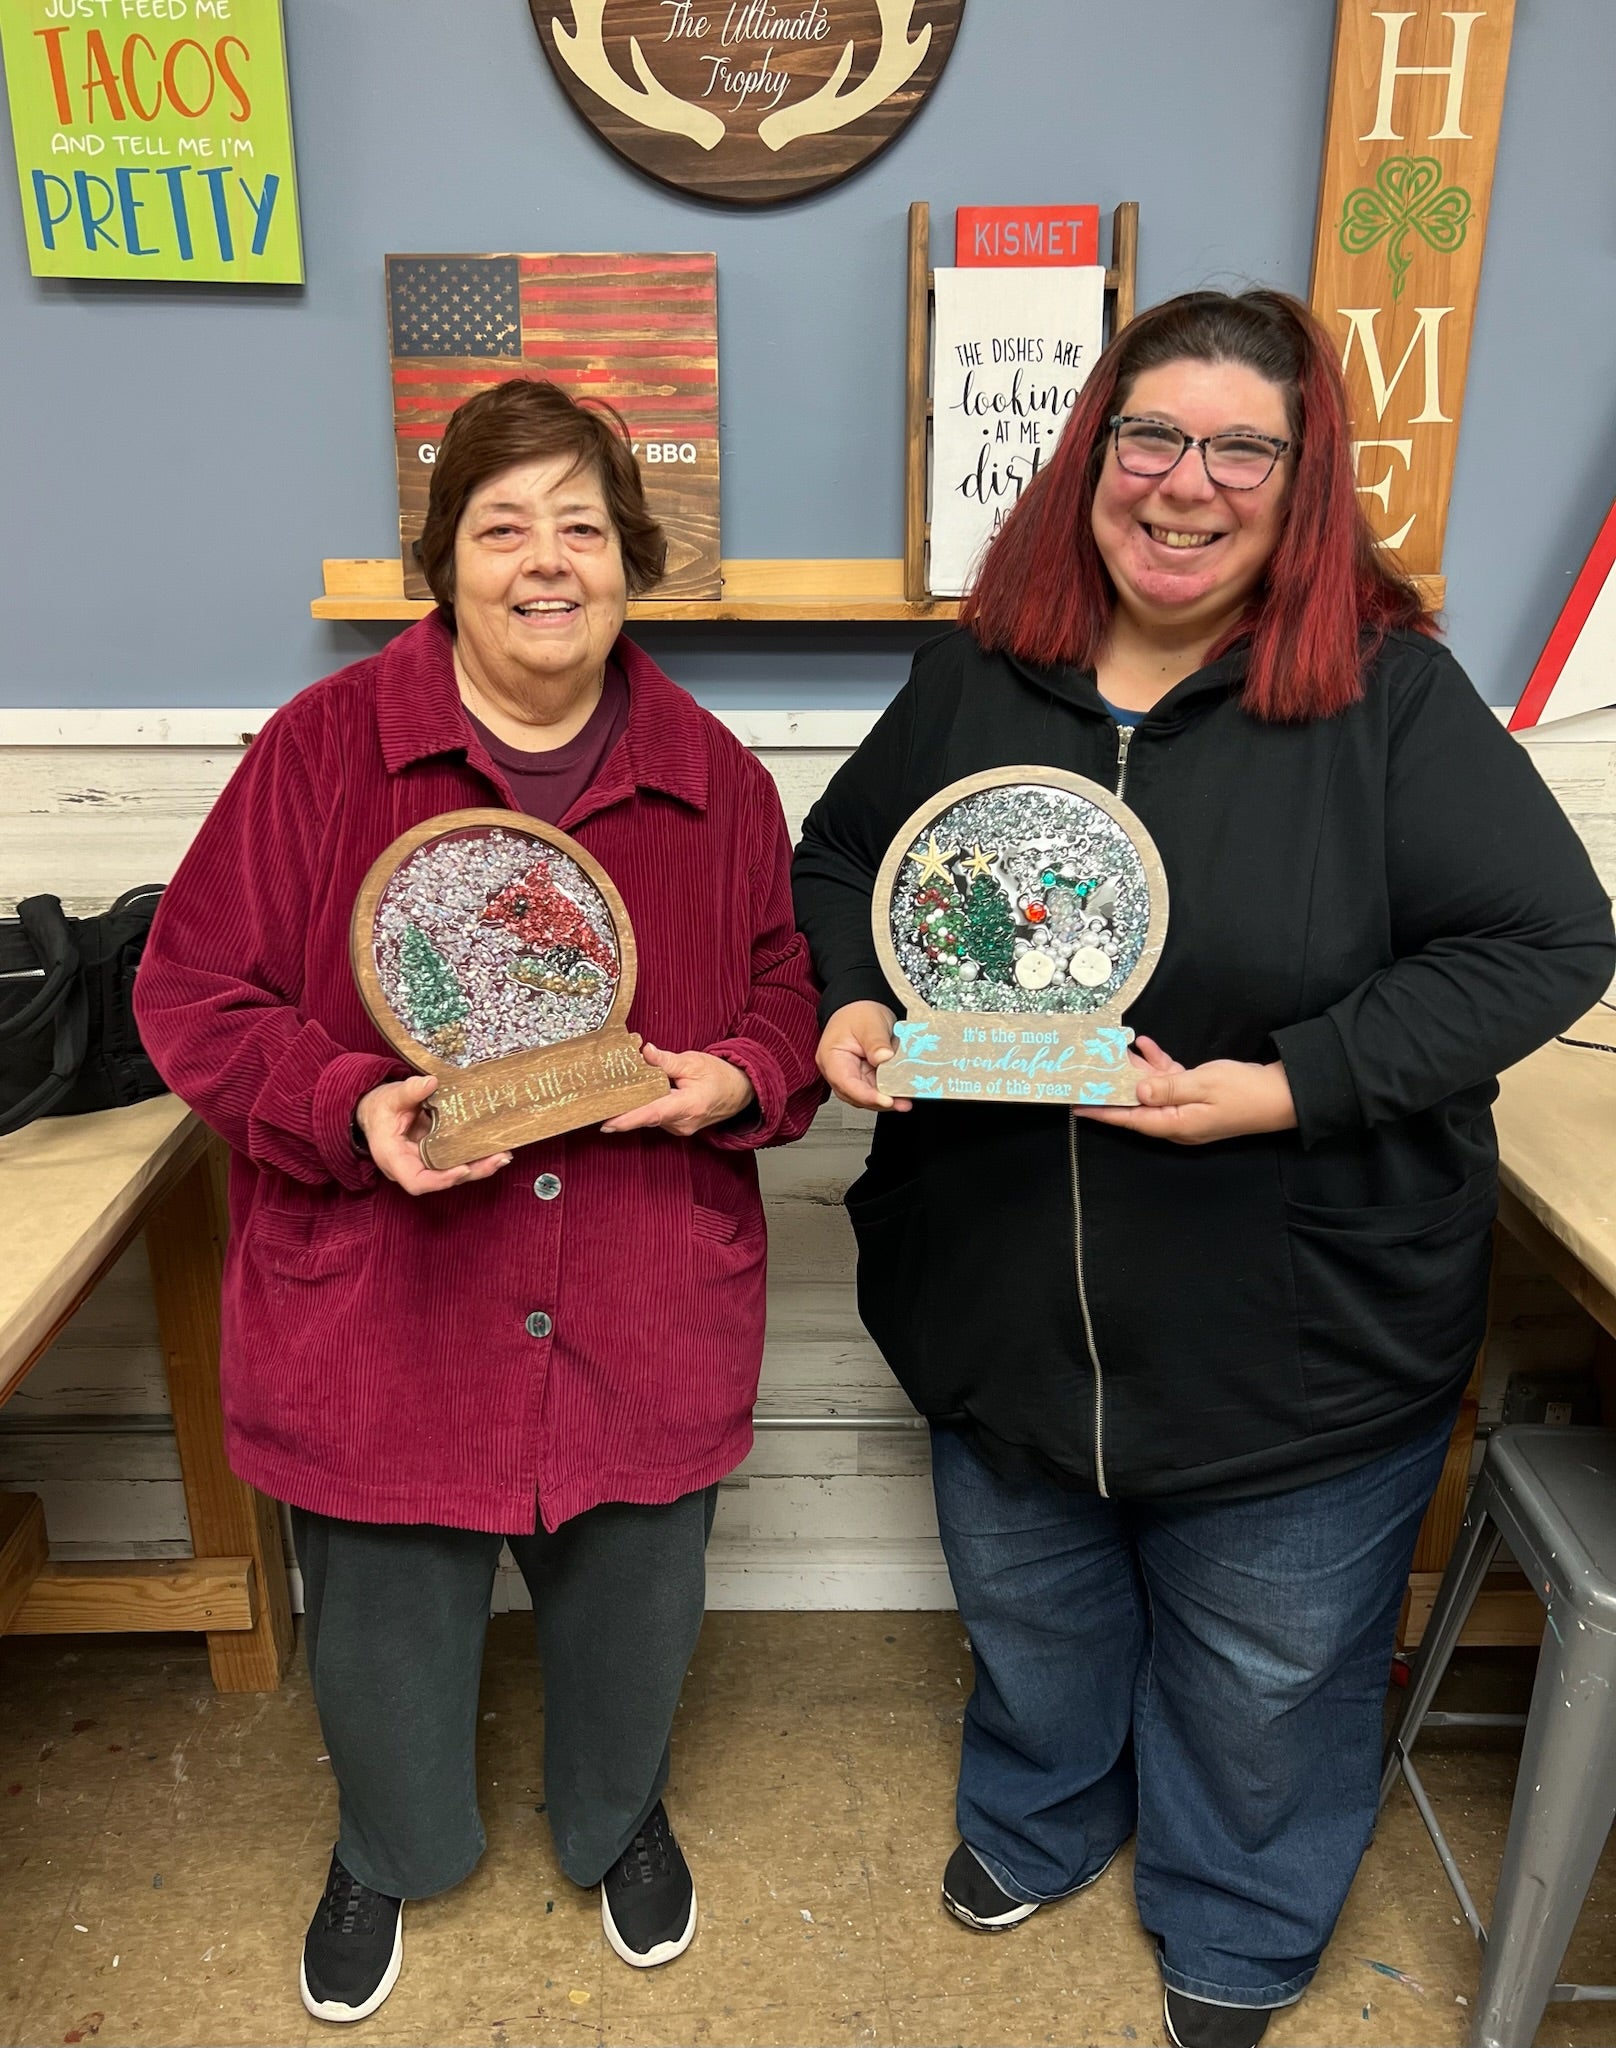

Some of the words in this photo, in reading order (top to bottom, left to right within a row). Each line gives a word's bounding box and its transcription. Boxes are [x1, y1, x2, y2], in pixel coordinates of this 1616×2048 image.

[45, 0, 112, 18] JUST
[121, 0, 187, 20] FEED
[195, 0, 231, 19] ME
[660, 0, 711, 43] The
[721, 0, 831, 47] Ultimate
[33, 26, 251, 125] TACOS
[699, 46, 791, 113] Trophy
[51, 133, 104, 155] AND
[112, 135, 171, 156] TELL
[178, 138, 213, 156] ME
[222, 138, 254, 158] I'M
[31, 165, 280, 262] PRETTY
[974, 221, 1083, 256] KISMET
[954, 341, 983, 368] THE
[992, 338, 1044, 363] DISHES
[1053, 340, 1083, 369] ARE
[995, 419, 1010, 444] AT
[1020, 420, 1040, 445] ME
[646, 443, 697, 464] BBQ
[955, 442, 1047, 505] dirt
[991, 1027, 1016, 1043] the
[1021, 1030, 1060, 1044] most
[950, 1045, 1075, 1079] wonderful
[947, 1077, 980, 1093] time
[986, 1079, 1002, 1095] of
[1006, 1079, 1030, 1095] the
[1035, 1083, 1072, 1099] year
